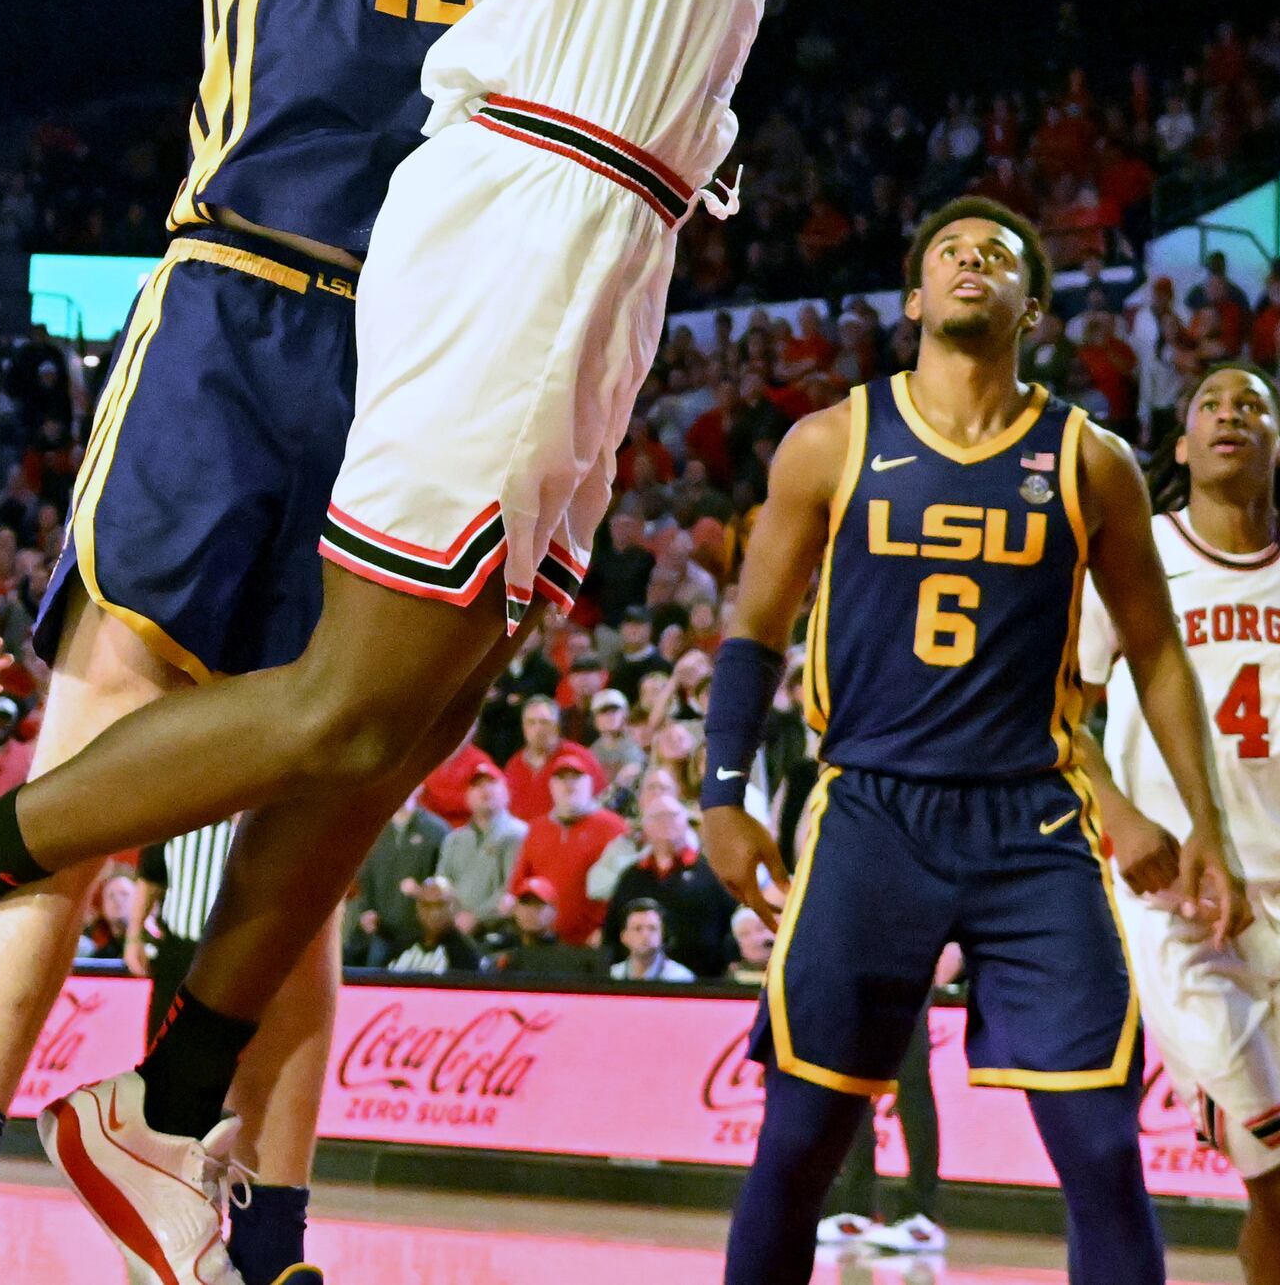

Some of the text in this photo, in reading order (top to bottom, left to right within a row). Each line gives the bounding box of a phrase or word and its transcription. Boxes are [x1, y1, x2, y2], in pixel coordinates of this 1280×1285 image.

[867, 499, 1048, 566] LSU
[913, 573, 981, 669] 6
[1214, 662, 1270, 759] 4
[343, 1097, 497, 1127] ZERO SUGAR
